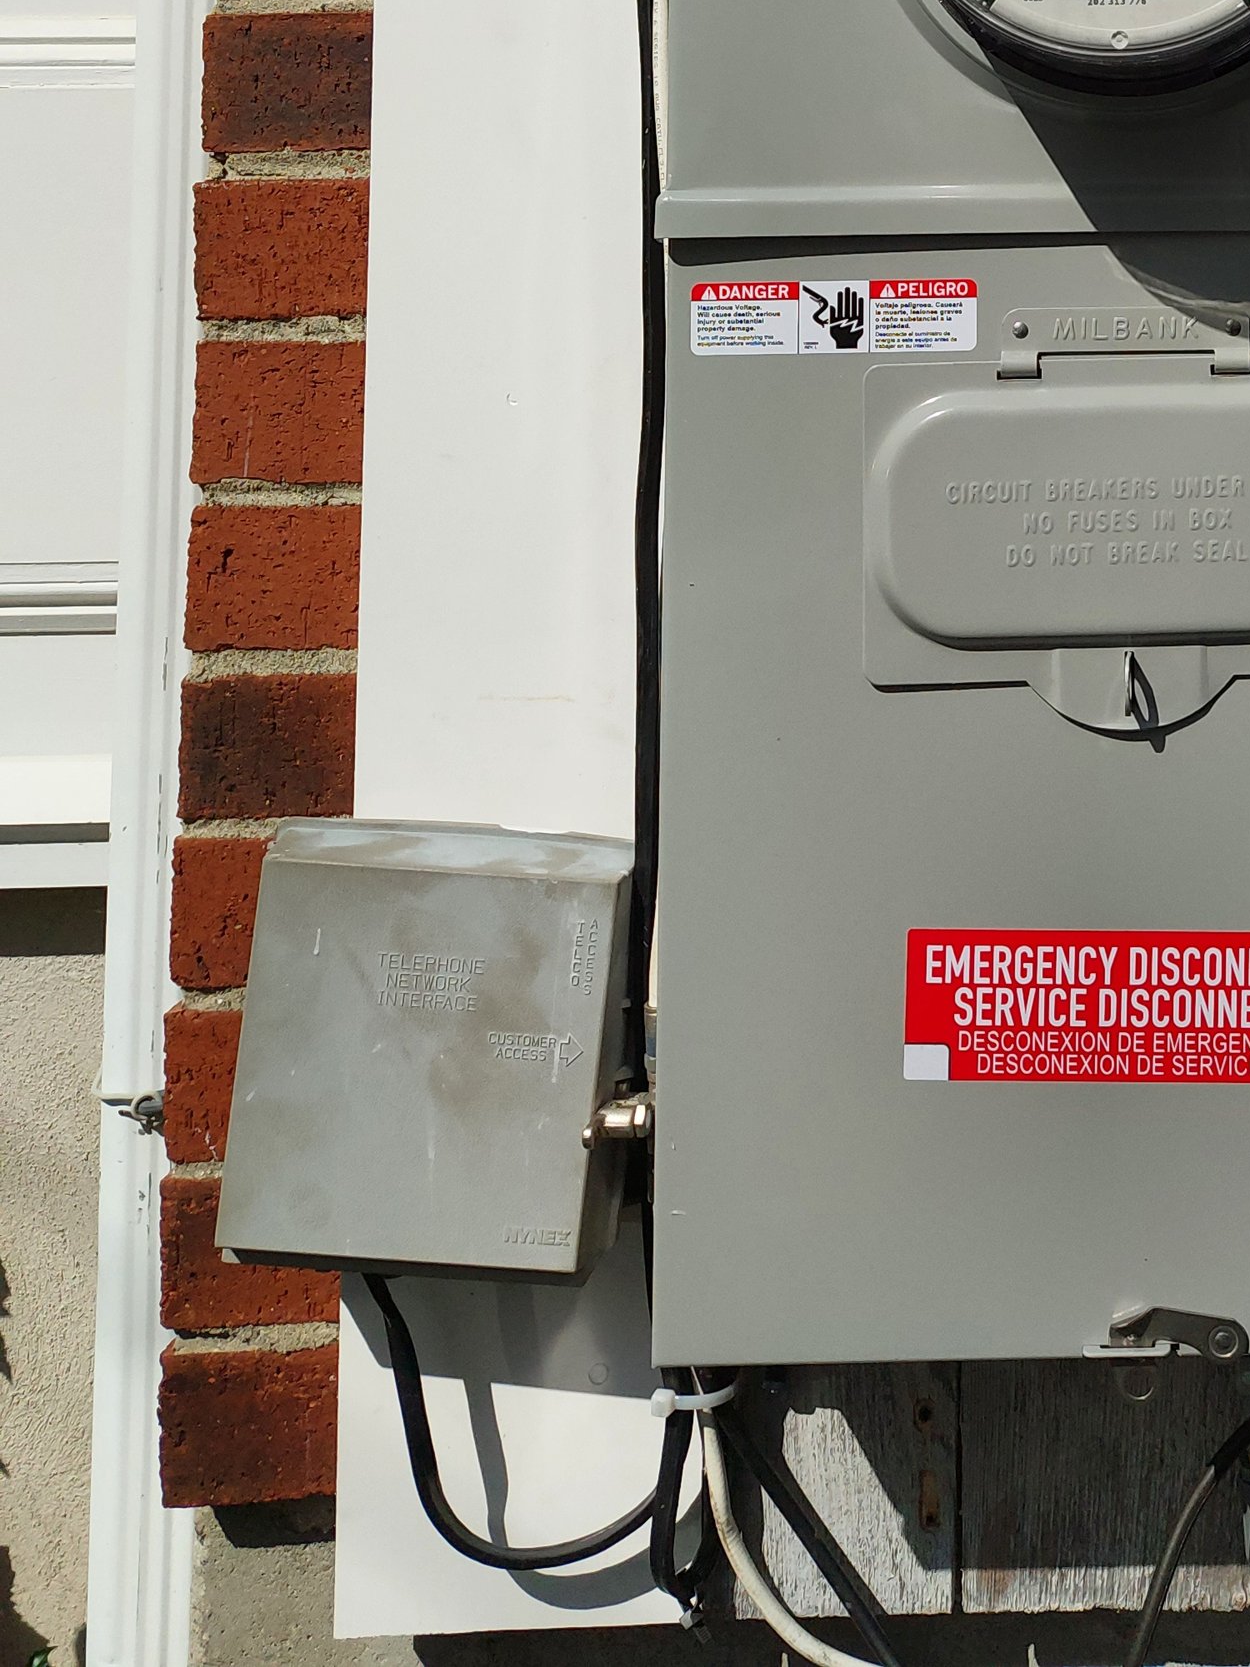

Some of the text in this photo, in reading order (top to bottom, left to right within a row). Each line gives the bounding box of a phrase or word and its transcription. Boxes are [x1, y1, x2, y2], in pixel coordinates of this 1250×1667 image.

[718, 284, 790, 301] DANGER
[897, 281, 969, 298] PELIGRO
[1052, 316, 1200, 341] MILBANK
[944, 479, 1033, 505] CIRCUIT
[1045, 477, 1161, 504] BREAKERS
[1170, 474, 1245, 499] UNDER
[1022, 507, 1233, 535] NO FUSES IN BOX
[1006, 539, 1249, 568] DO NOT BREAK SEAL
[376, 951, 486, 976] TELEPHONE
[571, 922, 585, 987] TELCO
[583, 918, 598, 996] ACCESS
[925, 944, 1119, 986] EMERGENCY
[386, 973, 472, 993] NETWORK
[376, 990, 478, 1013] INTERFACE
[953, 985, 1087, 1028] SERVICE
[487, 1031, 558, 1050] CUSTOMER
[958, 1030, 1114, 1054] DESCONEXION
[1118, 1032, 1144, 1054] DE
[494, 1047, 547, 1062] ACCESS
[977, 1053, 1130, 1076] DESCONEXION
[1137, 1054, 1166, 1076] DE
[503, 1227, 572, 1246] NYNEX
